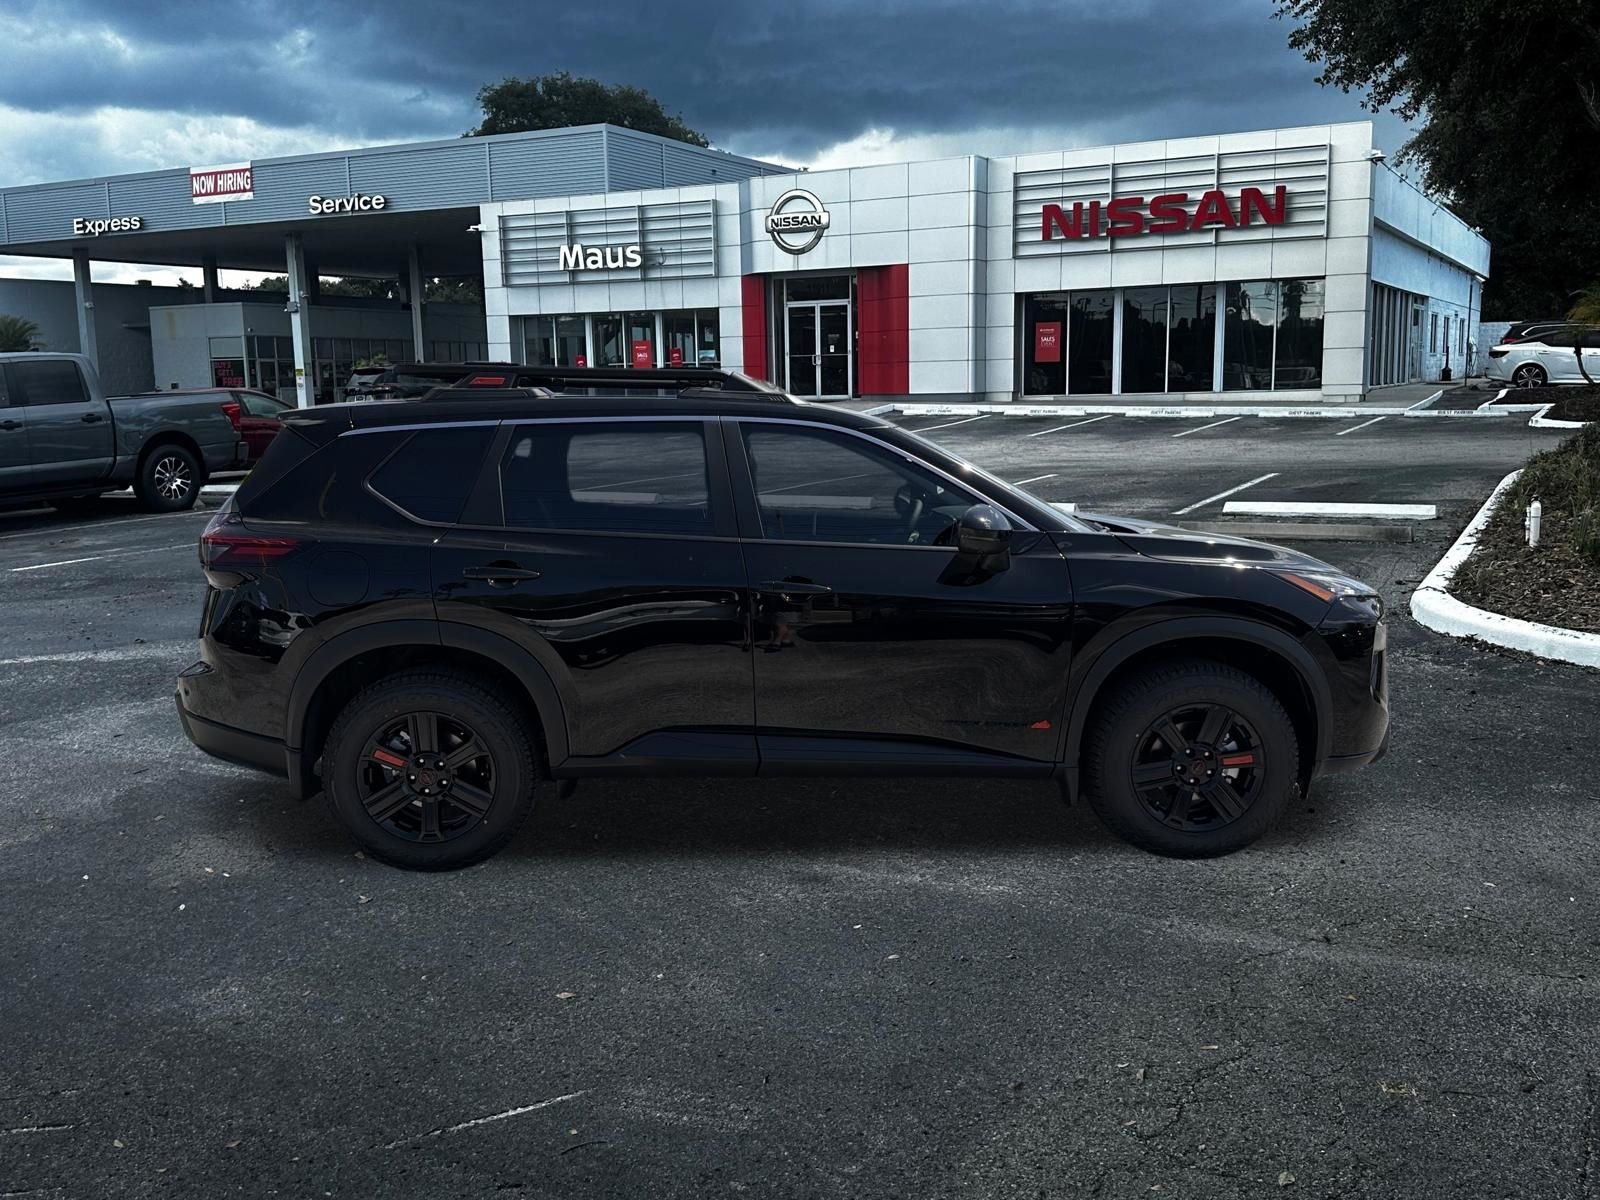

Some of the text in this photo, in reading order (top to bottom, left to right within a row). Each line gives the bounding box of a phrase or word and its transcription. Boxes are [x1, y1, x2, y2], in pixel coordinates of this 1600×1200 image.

[193, 170, 251, 194] NOW HIRING
[308, 193, 385, 215] Service
[1041, 185, 1287, 240] NISSAN
[73, 216, 141, 237] Express
[770, 214, 822, 229] NISSAN
[559, 244, 642, 271] Maus
[223, 377, 244, 386] FREE
